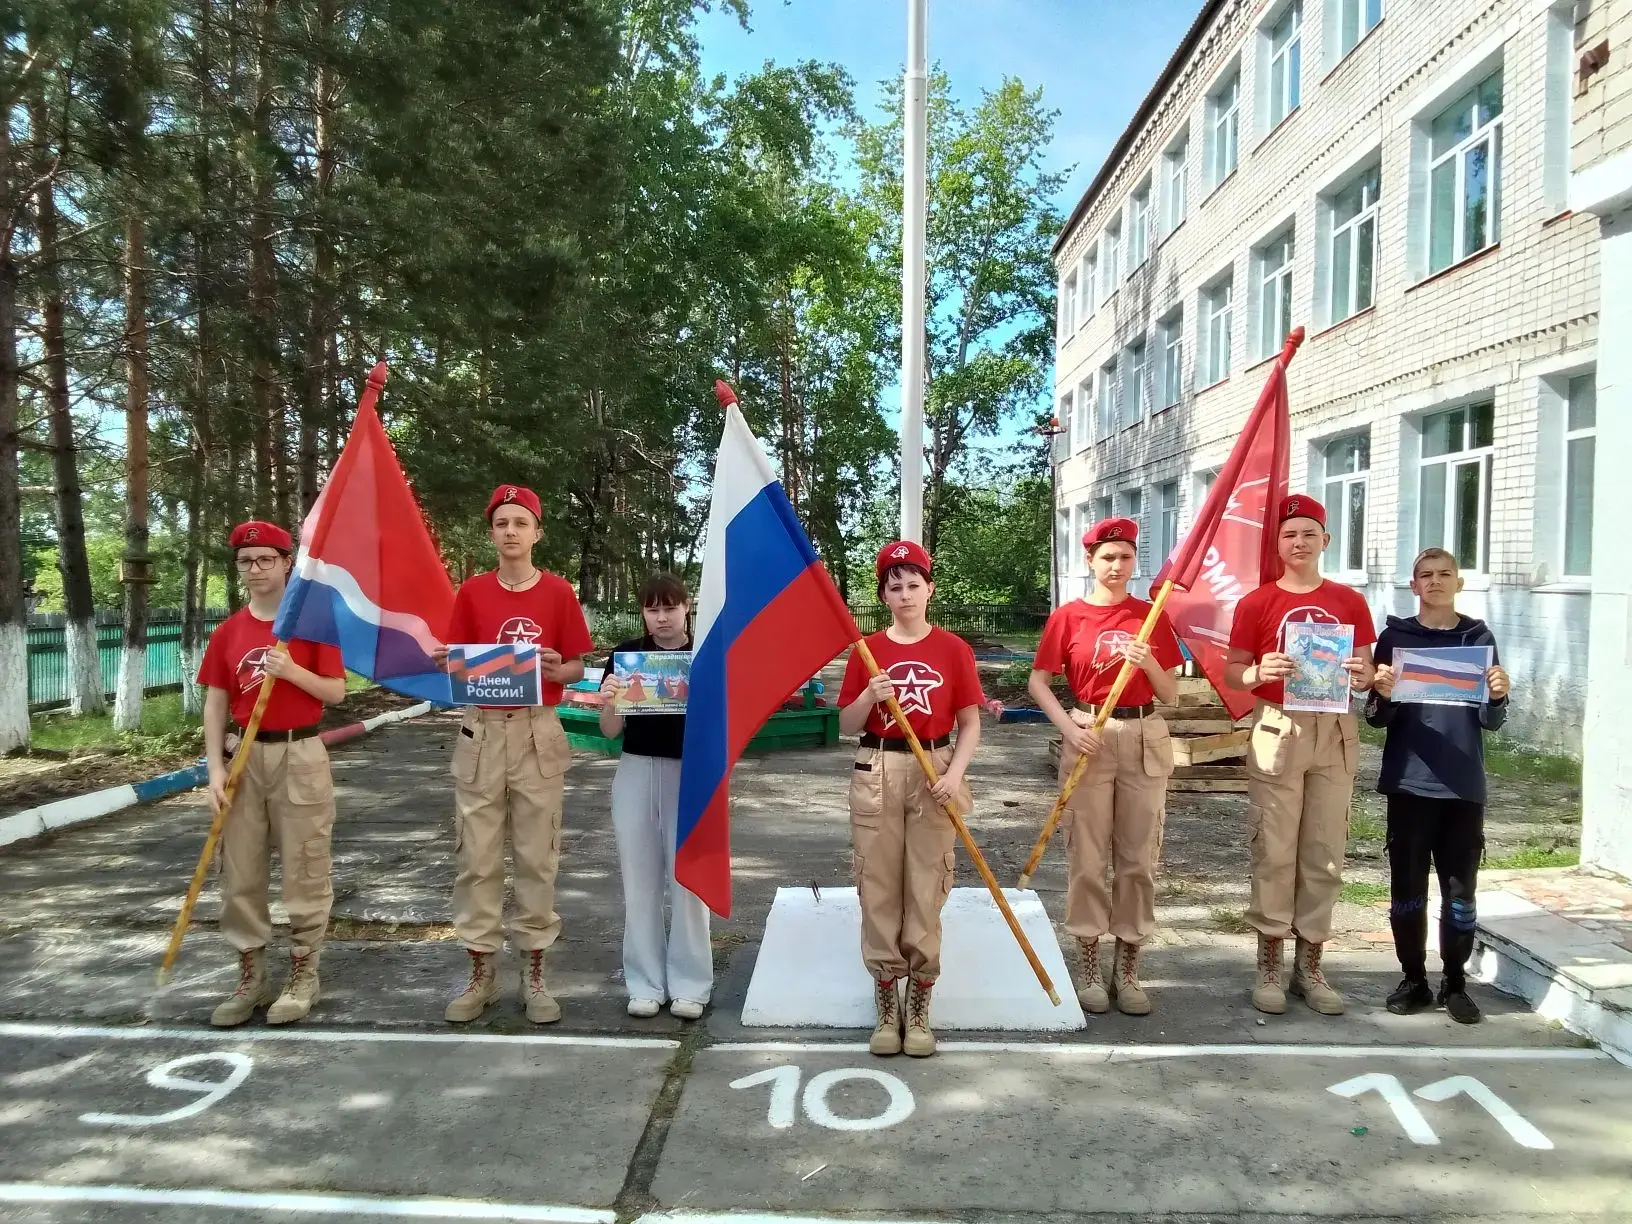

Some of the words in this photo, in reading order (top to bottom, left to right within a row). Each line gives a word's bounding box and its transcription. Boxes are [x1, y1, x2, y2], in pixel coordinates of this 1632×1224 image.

[466, 685, 524, 698] России!
[467, 674, 476, 685] С
[478, 674, 511, 687] Днем
[77, 1051, 254, 1127] 9
[728, 1064, 917, 1132] 10
[1325, 1072, 1555, 1150] 11
